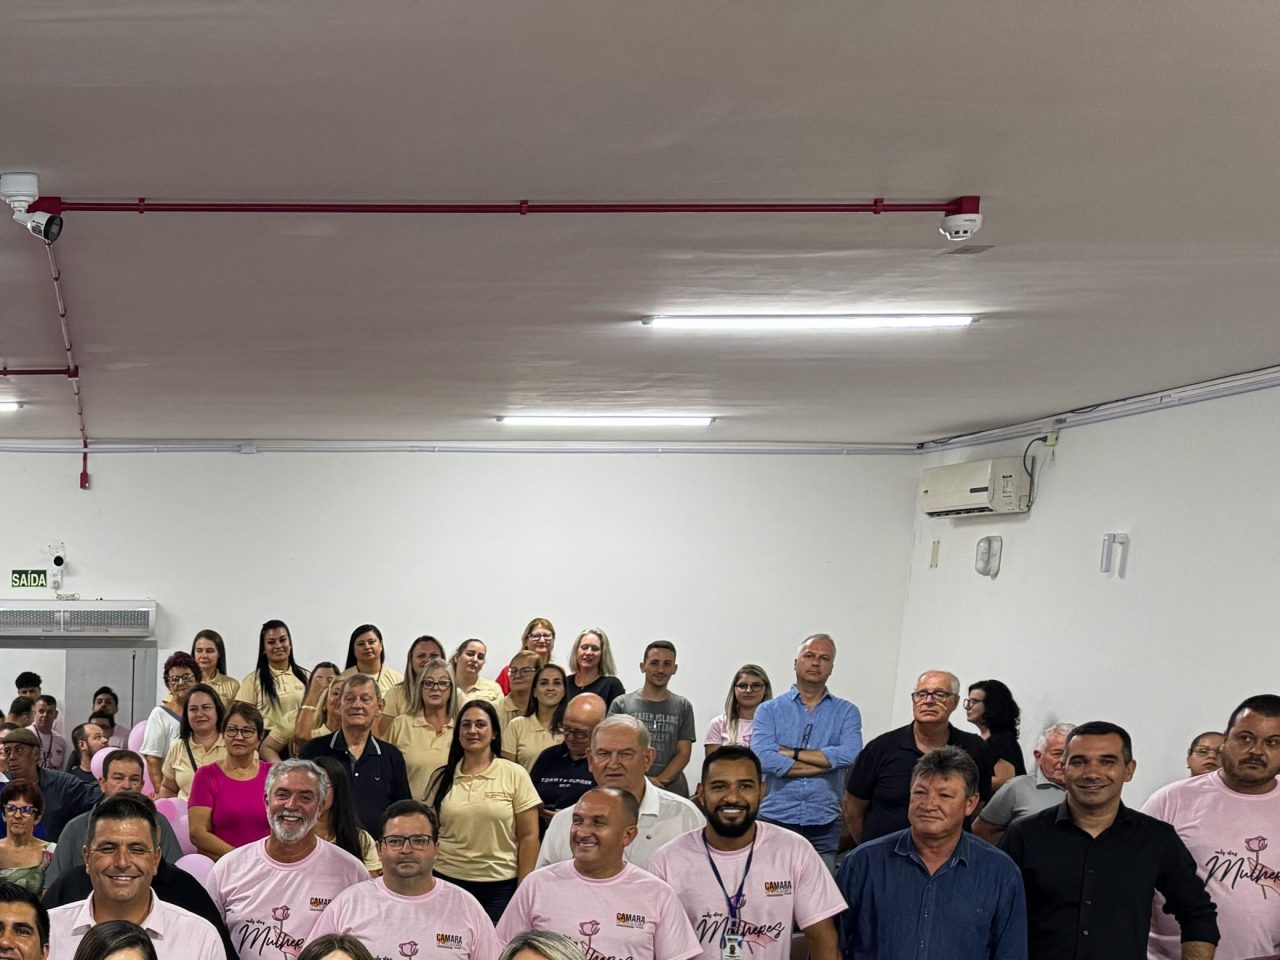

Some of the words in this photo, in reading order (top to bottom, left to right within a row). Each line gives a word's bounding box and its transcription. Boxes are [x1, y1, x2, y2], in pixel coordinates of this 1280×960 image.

[12, 570, 46, 586] SAÍDA
[310, 896, 332, 906] CAMAR
[616, 912, 646, 924] CAMARA
[436, 933, 462, 944] CAMARA
